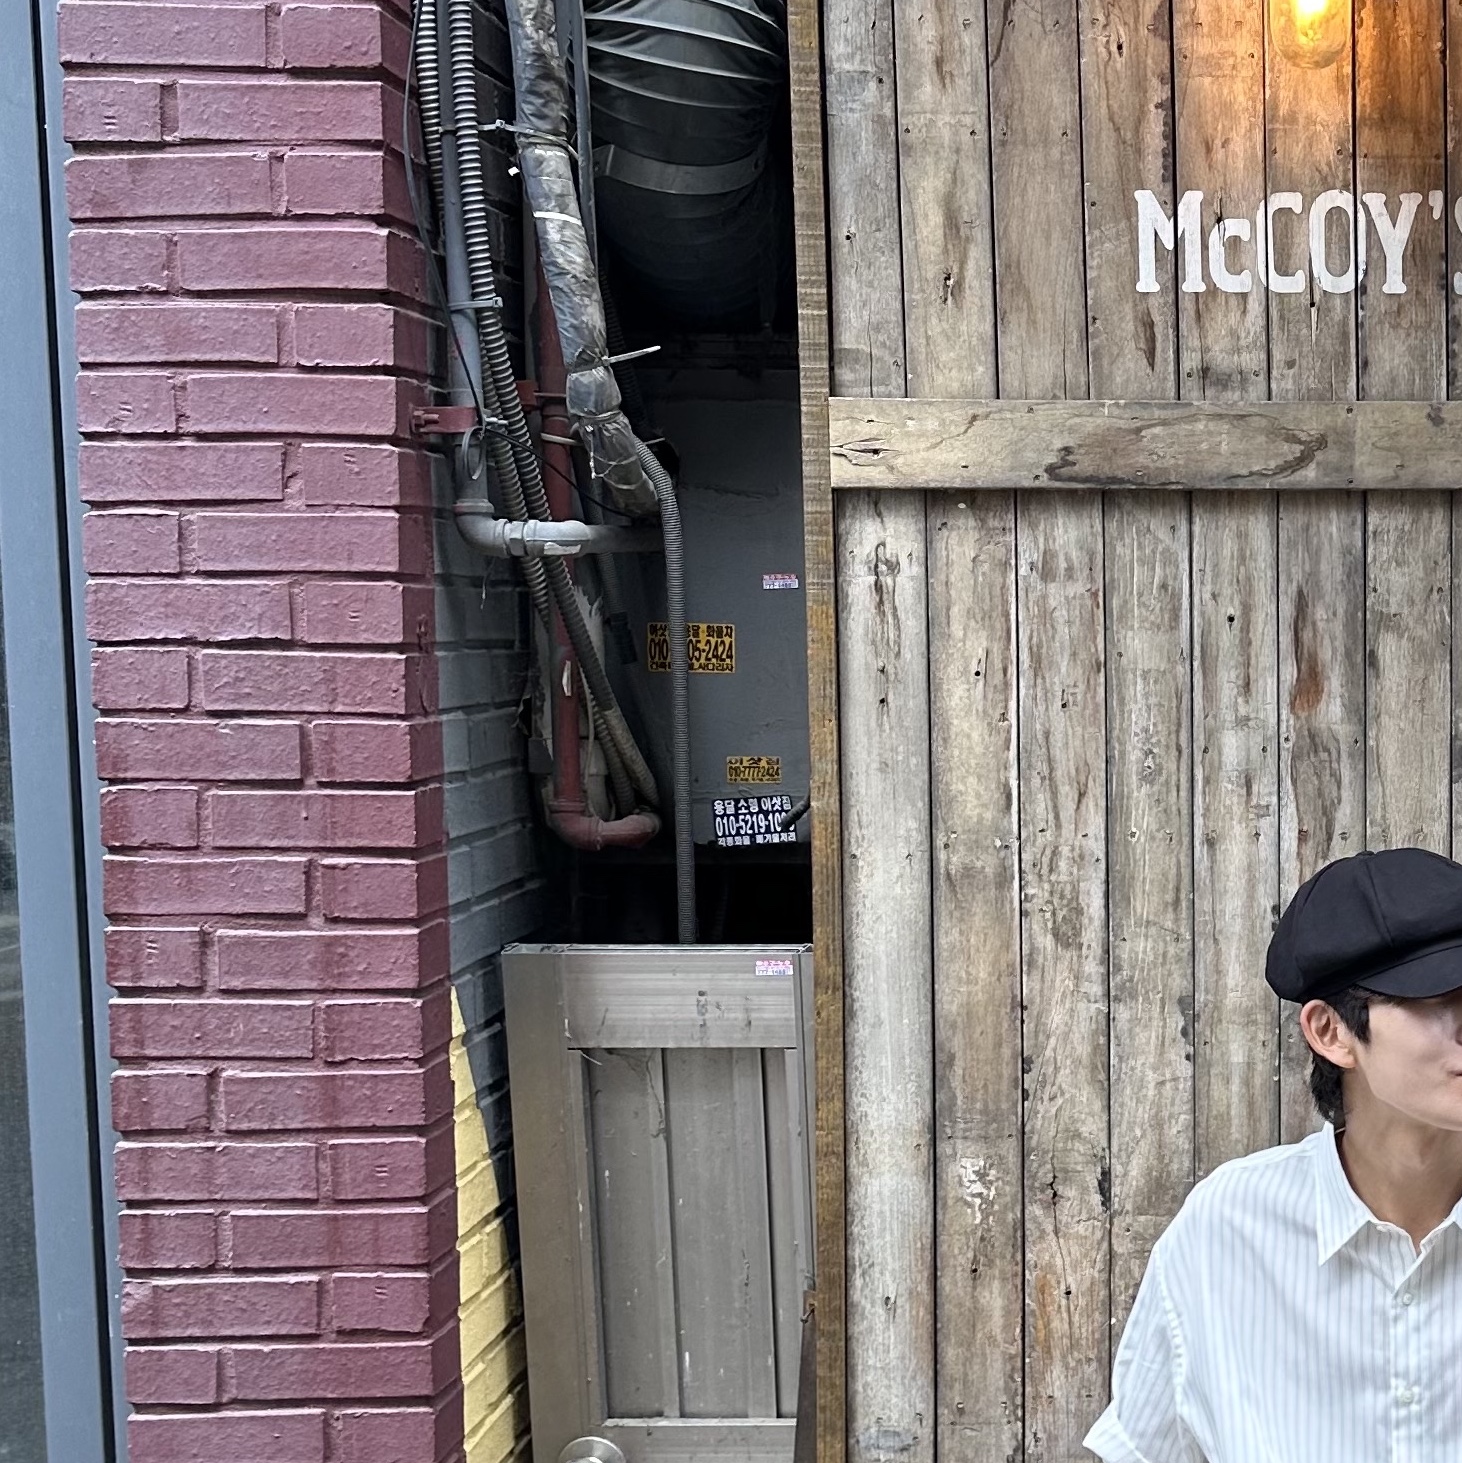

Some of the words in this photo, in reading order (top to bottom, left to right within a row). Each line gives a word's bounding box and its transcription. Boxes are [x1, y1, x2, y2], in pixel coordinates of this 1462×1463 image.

[714, 800, 735, 815] 용달
[761, 796, 792, 811] 이삿짐
[716, 812, 795, 836] 010-5219-10
